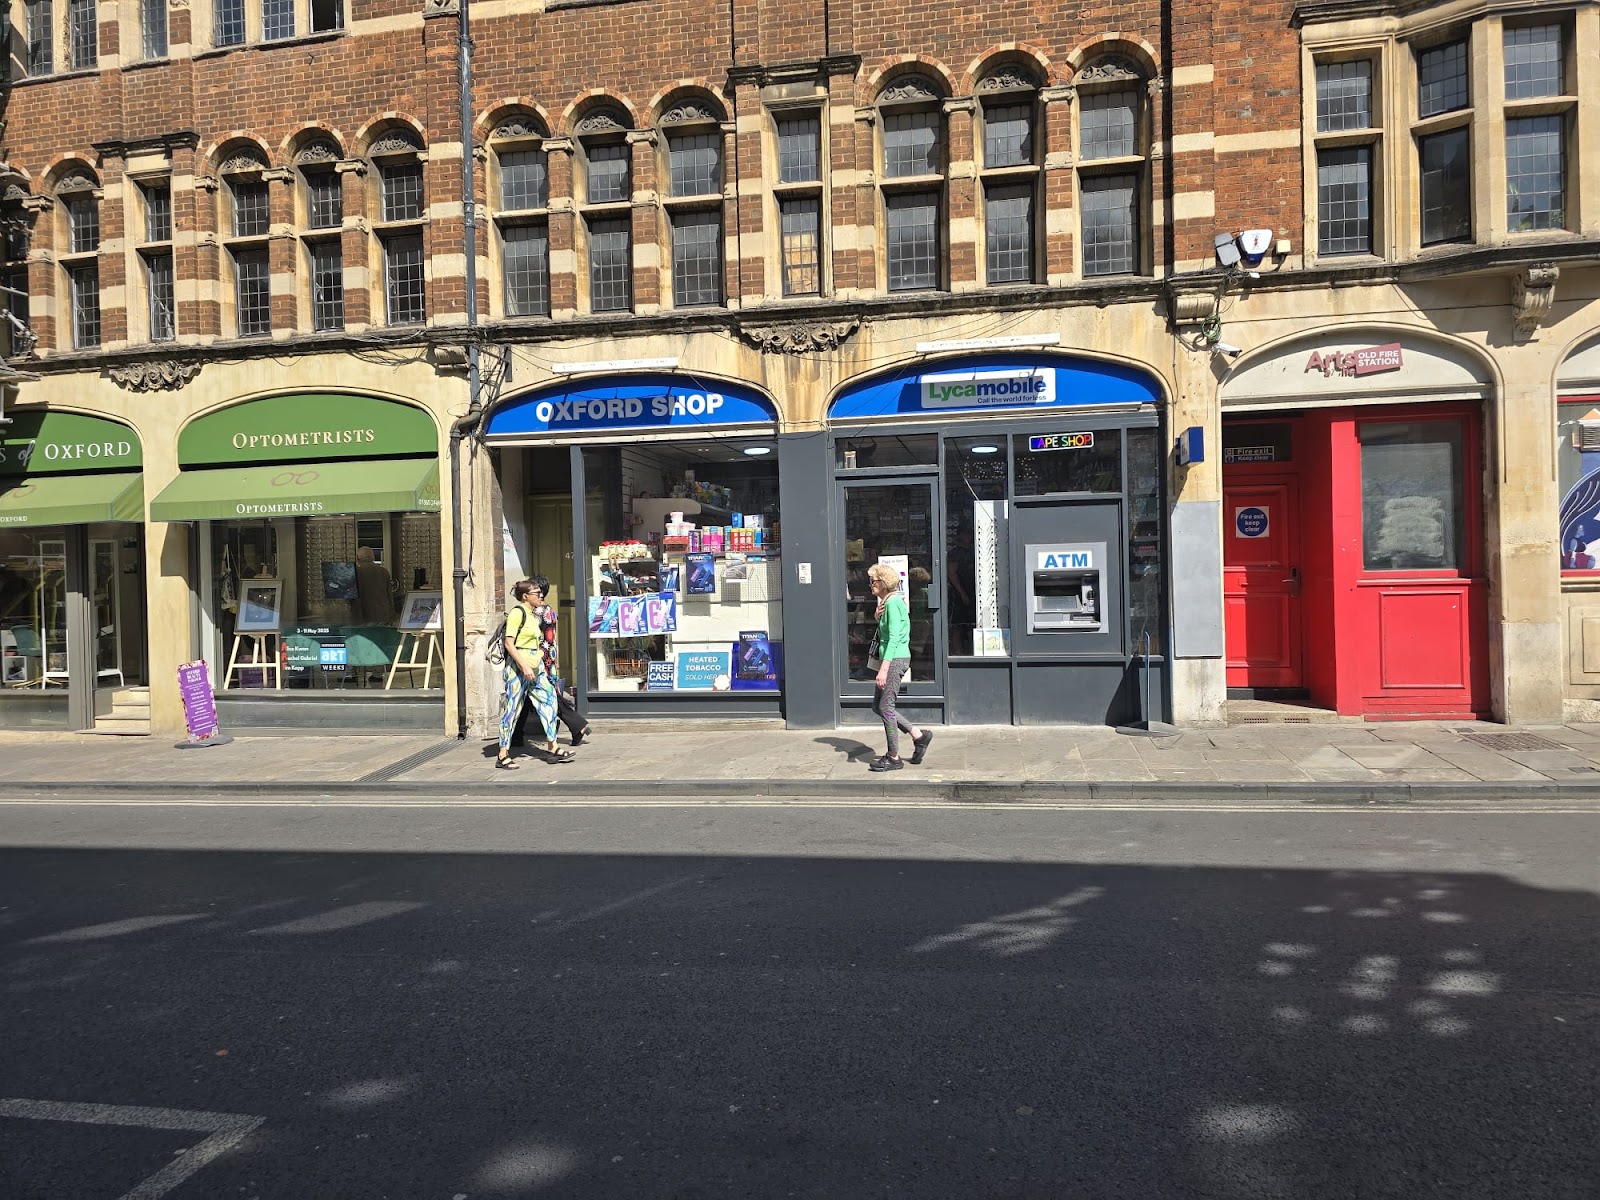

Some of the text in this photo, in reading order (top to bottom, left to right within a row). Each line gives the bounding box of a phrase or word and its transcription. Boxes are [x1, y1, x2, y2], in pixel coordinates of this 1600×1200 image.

[1306, 351, 1356, 369] Arts
[1358, 350, 1399, 359] OLD FIRE
[1358, 358, 1399, 367] STATION
[929, 377, 1047, 402] Lycamobile
[535, 393, 724, 423] OXFORD SHOP
[232, 429, 375, 449] OPTOMETRISTS
[1031, 434, 1091, 449] VAPE SHOP
[18, 439, 36, 467] of
[45, 441, 131, 460] OXFORD
[235, 501, 324, 514] OPTOMETRISTS
[1044, 554, 1088, 568] ATM
[650, 664, 674, 672] FREE
[649, 672, 674, 681] CASH
